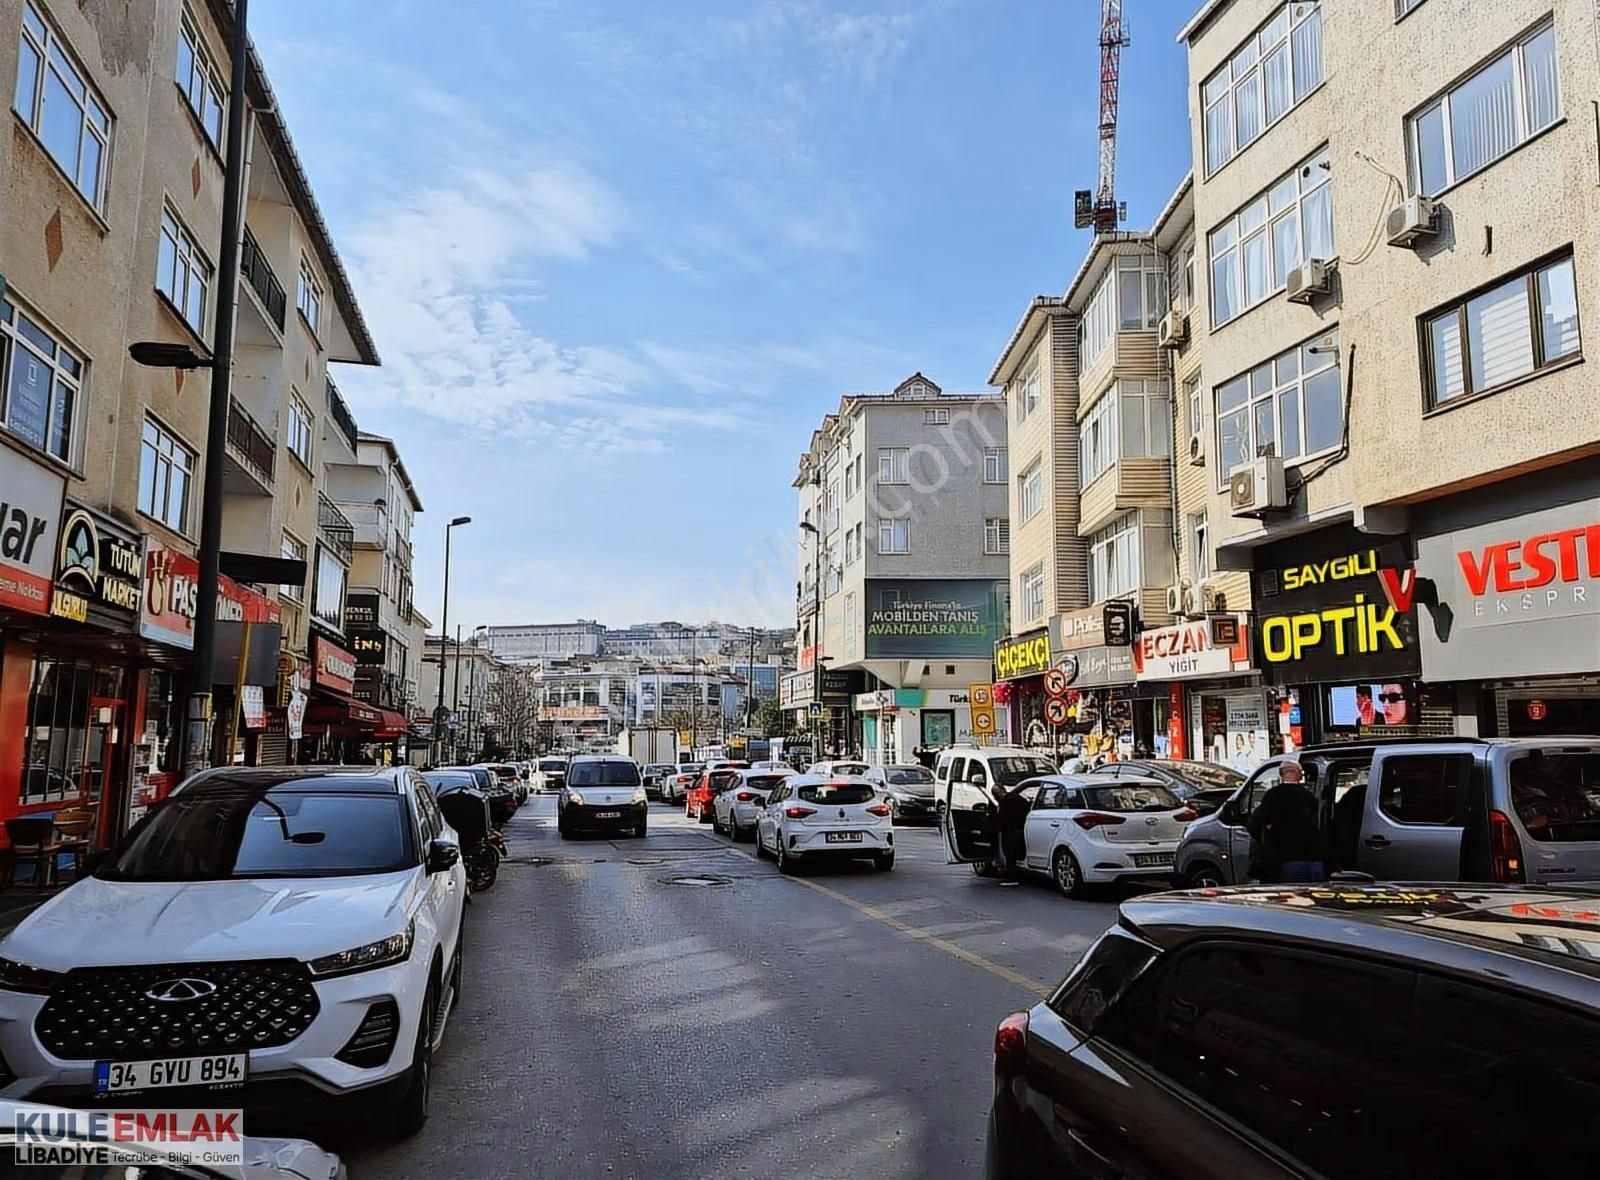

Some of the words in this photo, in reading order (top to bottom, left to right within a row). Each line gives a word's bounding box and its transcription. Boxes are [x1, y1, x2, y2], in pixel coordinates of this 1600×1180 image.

[111, 539, 142, 579] TÜTÜN
[1283, 549, 1377, 591] SAYGILI
[102, 576, 141, 612] MARKET
[872, 608, 939, 622] MOBİLDEN
[941, 611, 979, 624] TANIŞ
[1263, 593, 1404, 662] OPTİK
[997, 630, 1050, 678] ÇİÇEKÇİ
[1142, 625, 1211, 660] ECZAN
[949, 694, 971, 704] Türk
[111, 1064, 137, 1088] 34
[150, 1060, 191, 1085] GVU
[201, 1056, 240, 1081] 894
